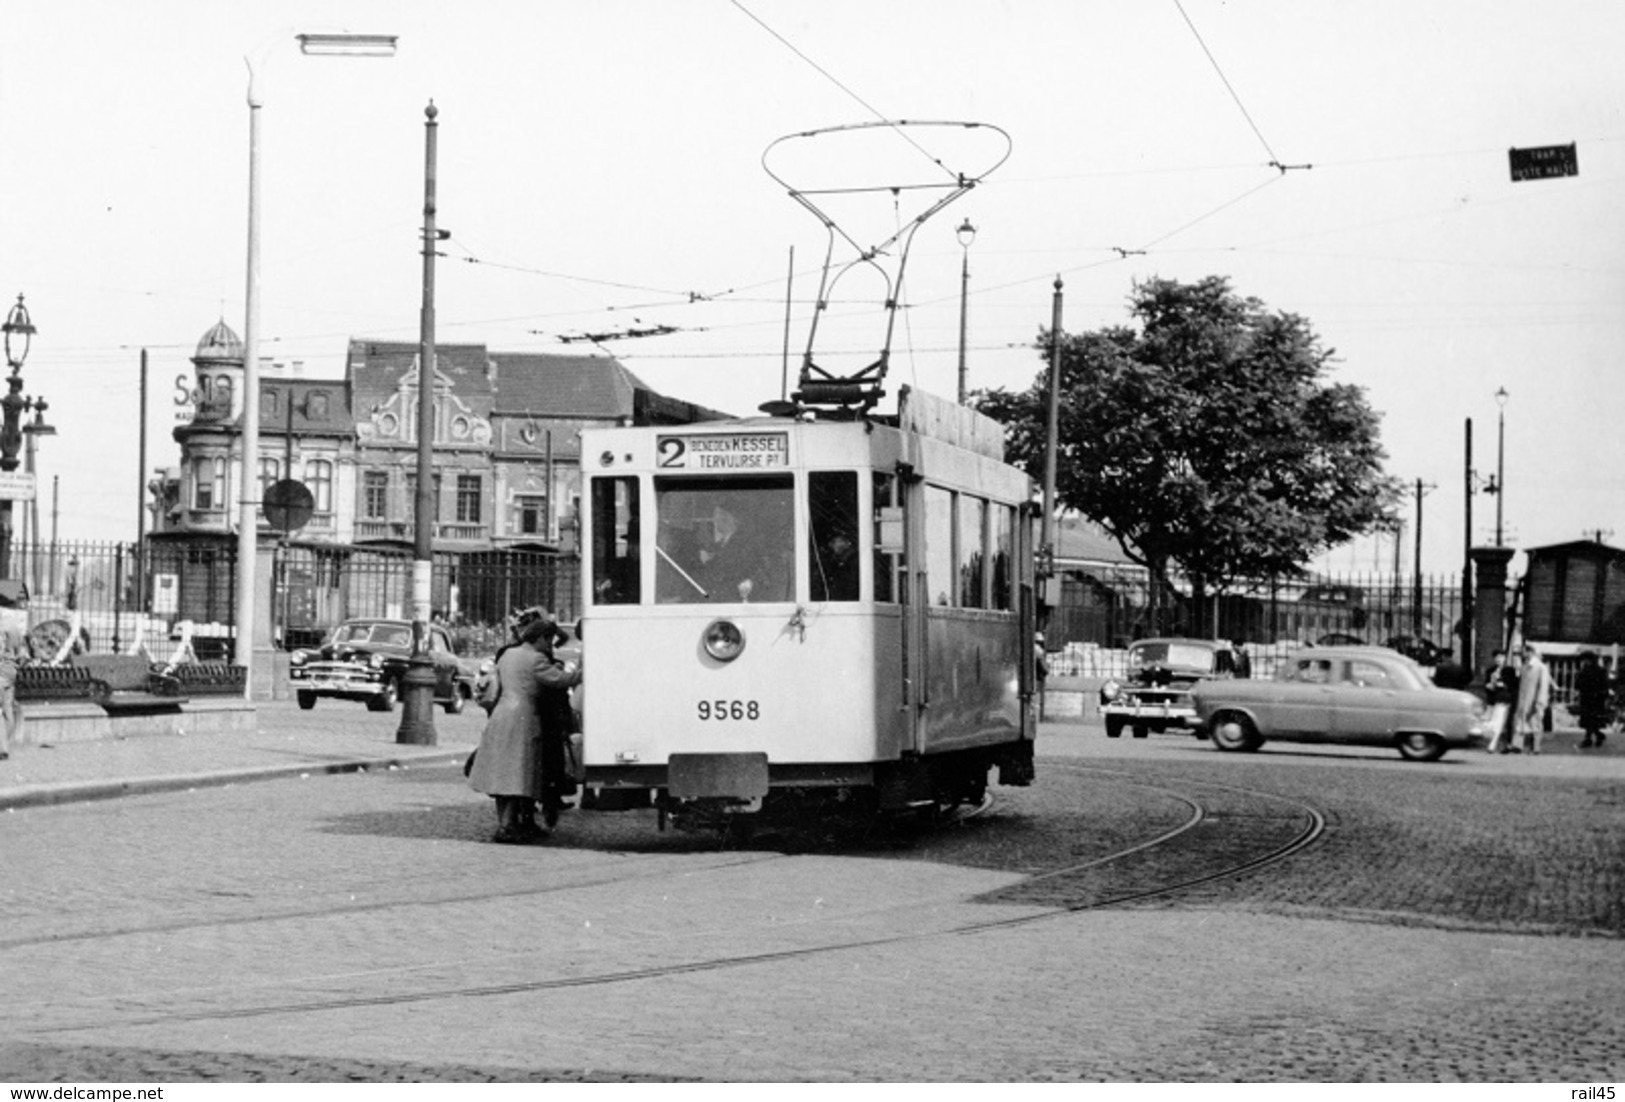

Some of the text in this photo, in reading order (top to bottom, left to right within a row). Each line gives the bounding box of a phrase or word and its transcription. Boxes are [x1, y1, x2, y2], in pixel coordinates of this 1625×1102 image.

[657, 438, 686, 468] 2
[691, 437, 785, 452] BENEDEN KESSEL
[699, 453, 763, 468] TERVUURSE
[698, 700, 760, 721] 9568
